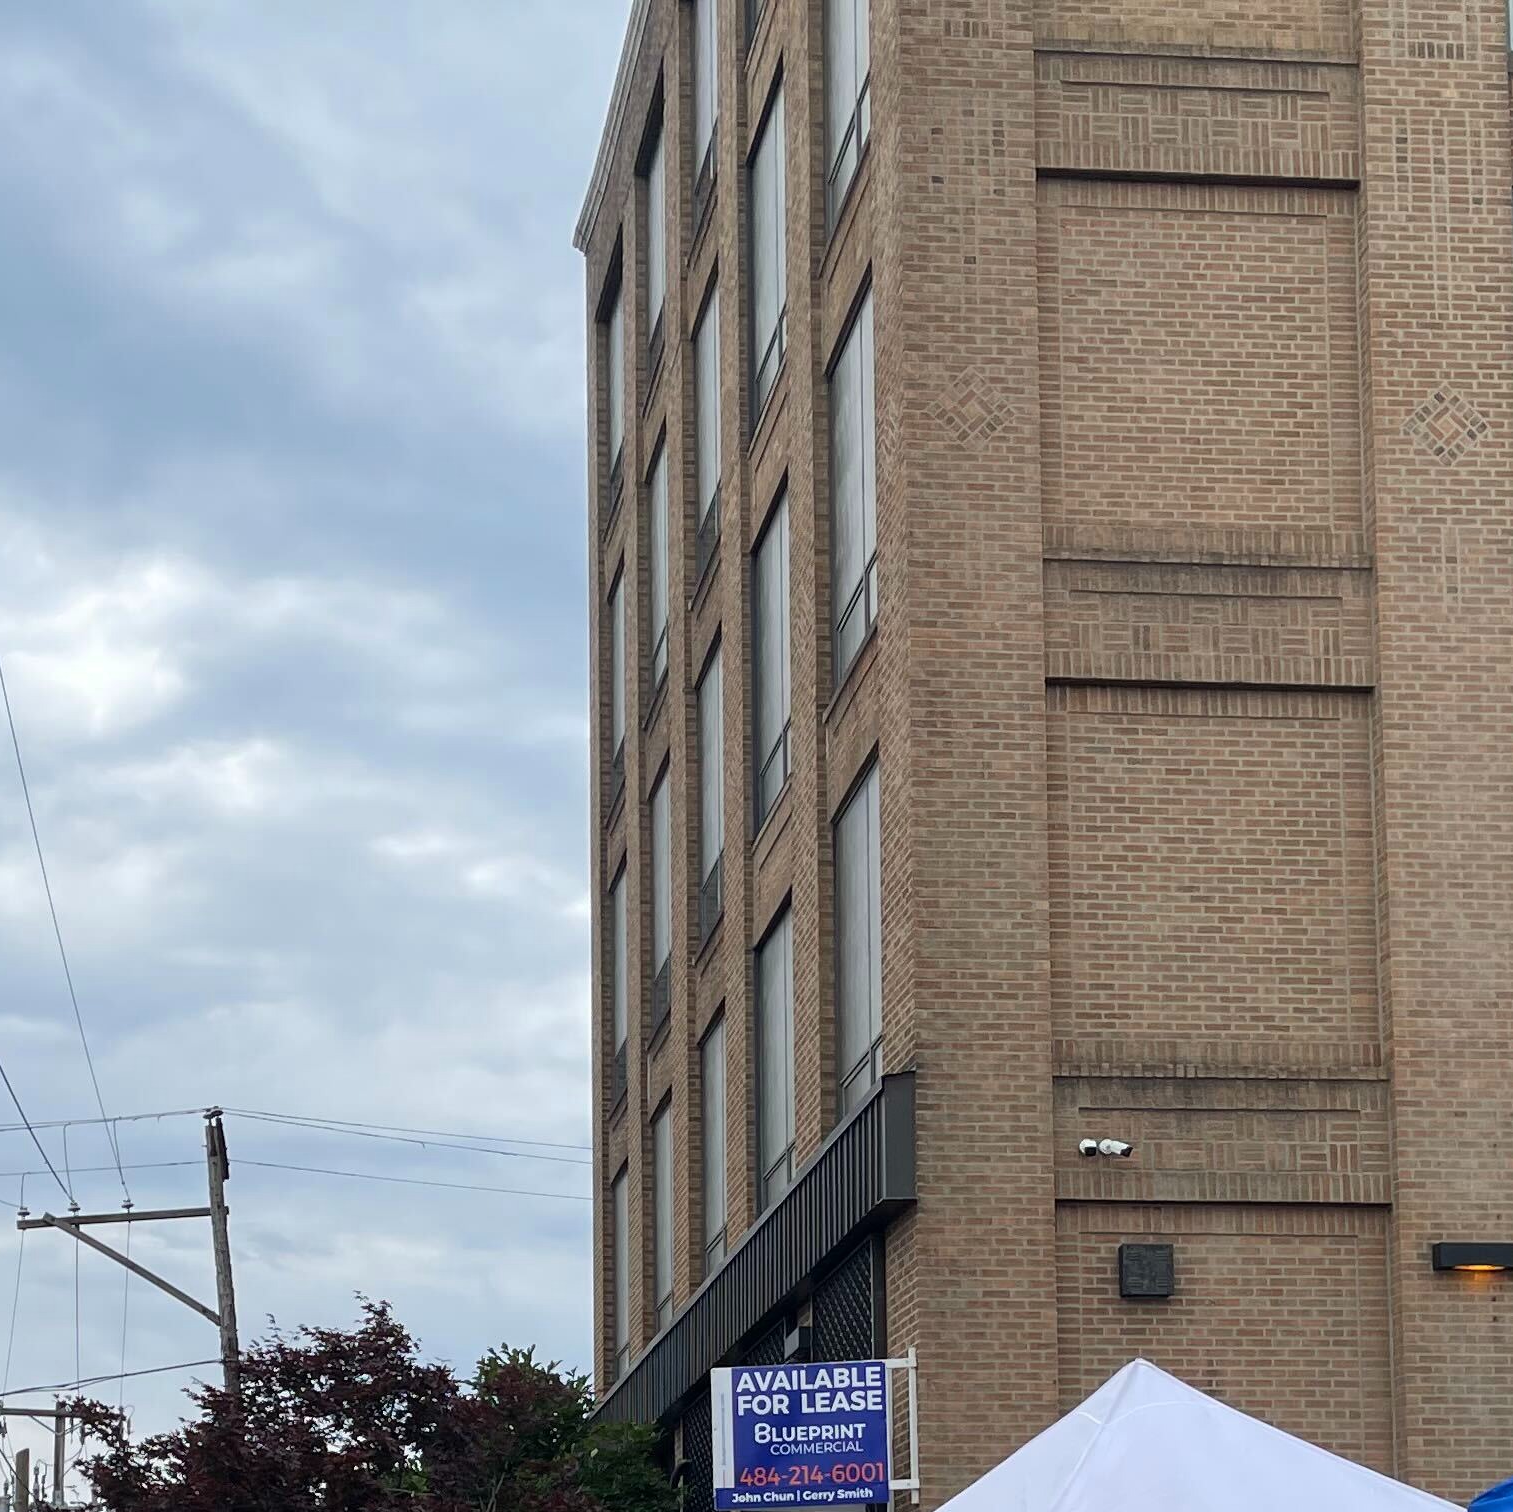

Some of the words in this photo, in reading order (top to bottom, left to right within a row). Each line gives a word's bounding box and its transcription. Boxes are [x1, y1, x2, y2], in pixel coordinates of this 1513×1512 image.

[736, 1366, 882, 1393] AVAILABLE
[737, 1394, 789, 1416] FOR
[801, 1390, 883, 1414] LEASE
[754, 1422, 866, 1444] BLUEPRINT
[770, 1440, 864, 1455] COMMERCIAL
[739, 1461, 884, 1487] 484-214-6001
[732, 1493, 761, 1503] John
[763, 1491, 794, 1502] Chun
[836, 1487, 874, 1499] Smith
